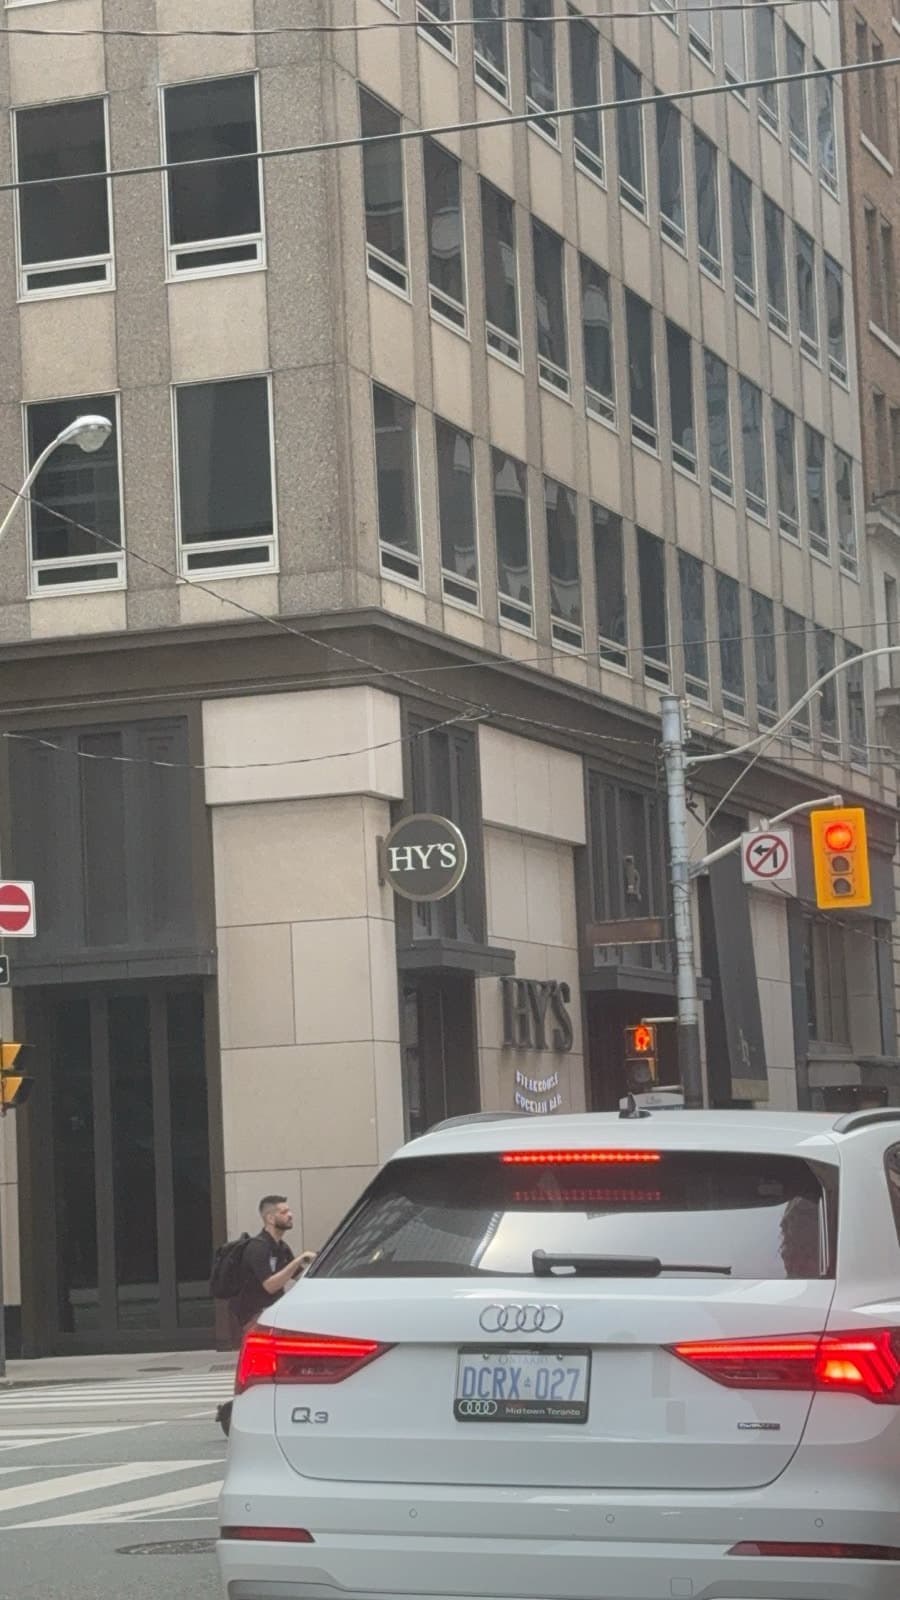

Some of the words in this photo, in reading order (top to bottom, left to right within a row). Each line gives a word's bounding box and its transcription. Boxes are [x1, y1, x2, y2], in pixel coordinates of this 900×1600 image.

[388, 842, 457, 872] HY'S
[499, 976, 573, 1052] HY'S
[462, 1366, 522, 1400] DCRX
[535, 1368, 580, 1401] 027
[291, 1406, 329, 1424] Q3
[505, 1407, 546, 1416] Midtown
[547, 1408, 581, 1417] Toronto
